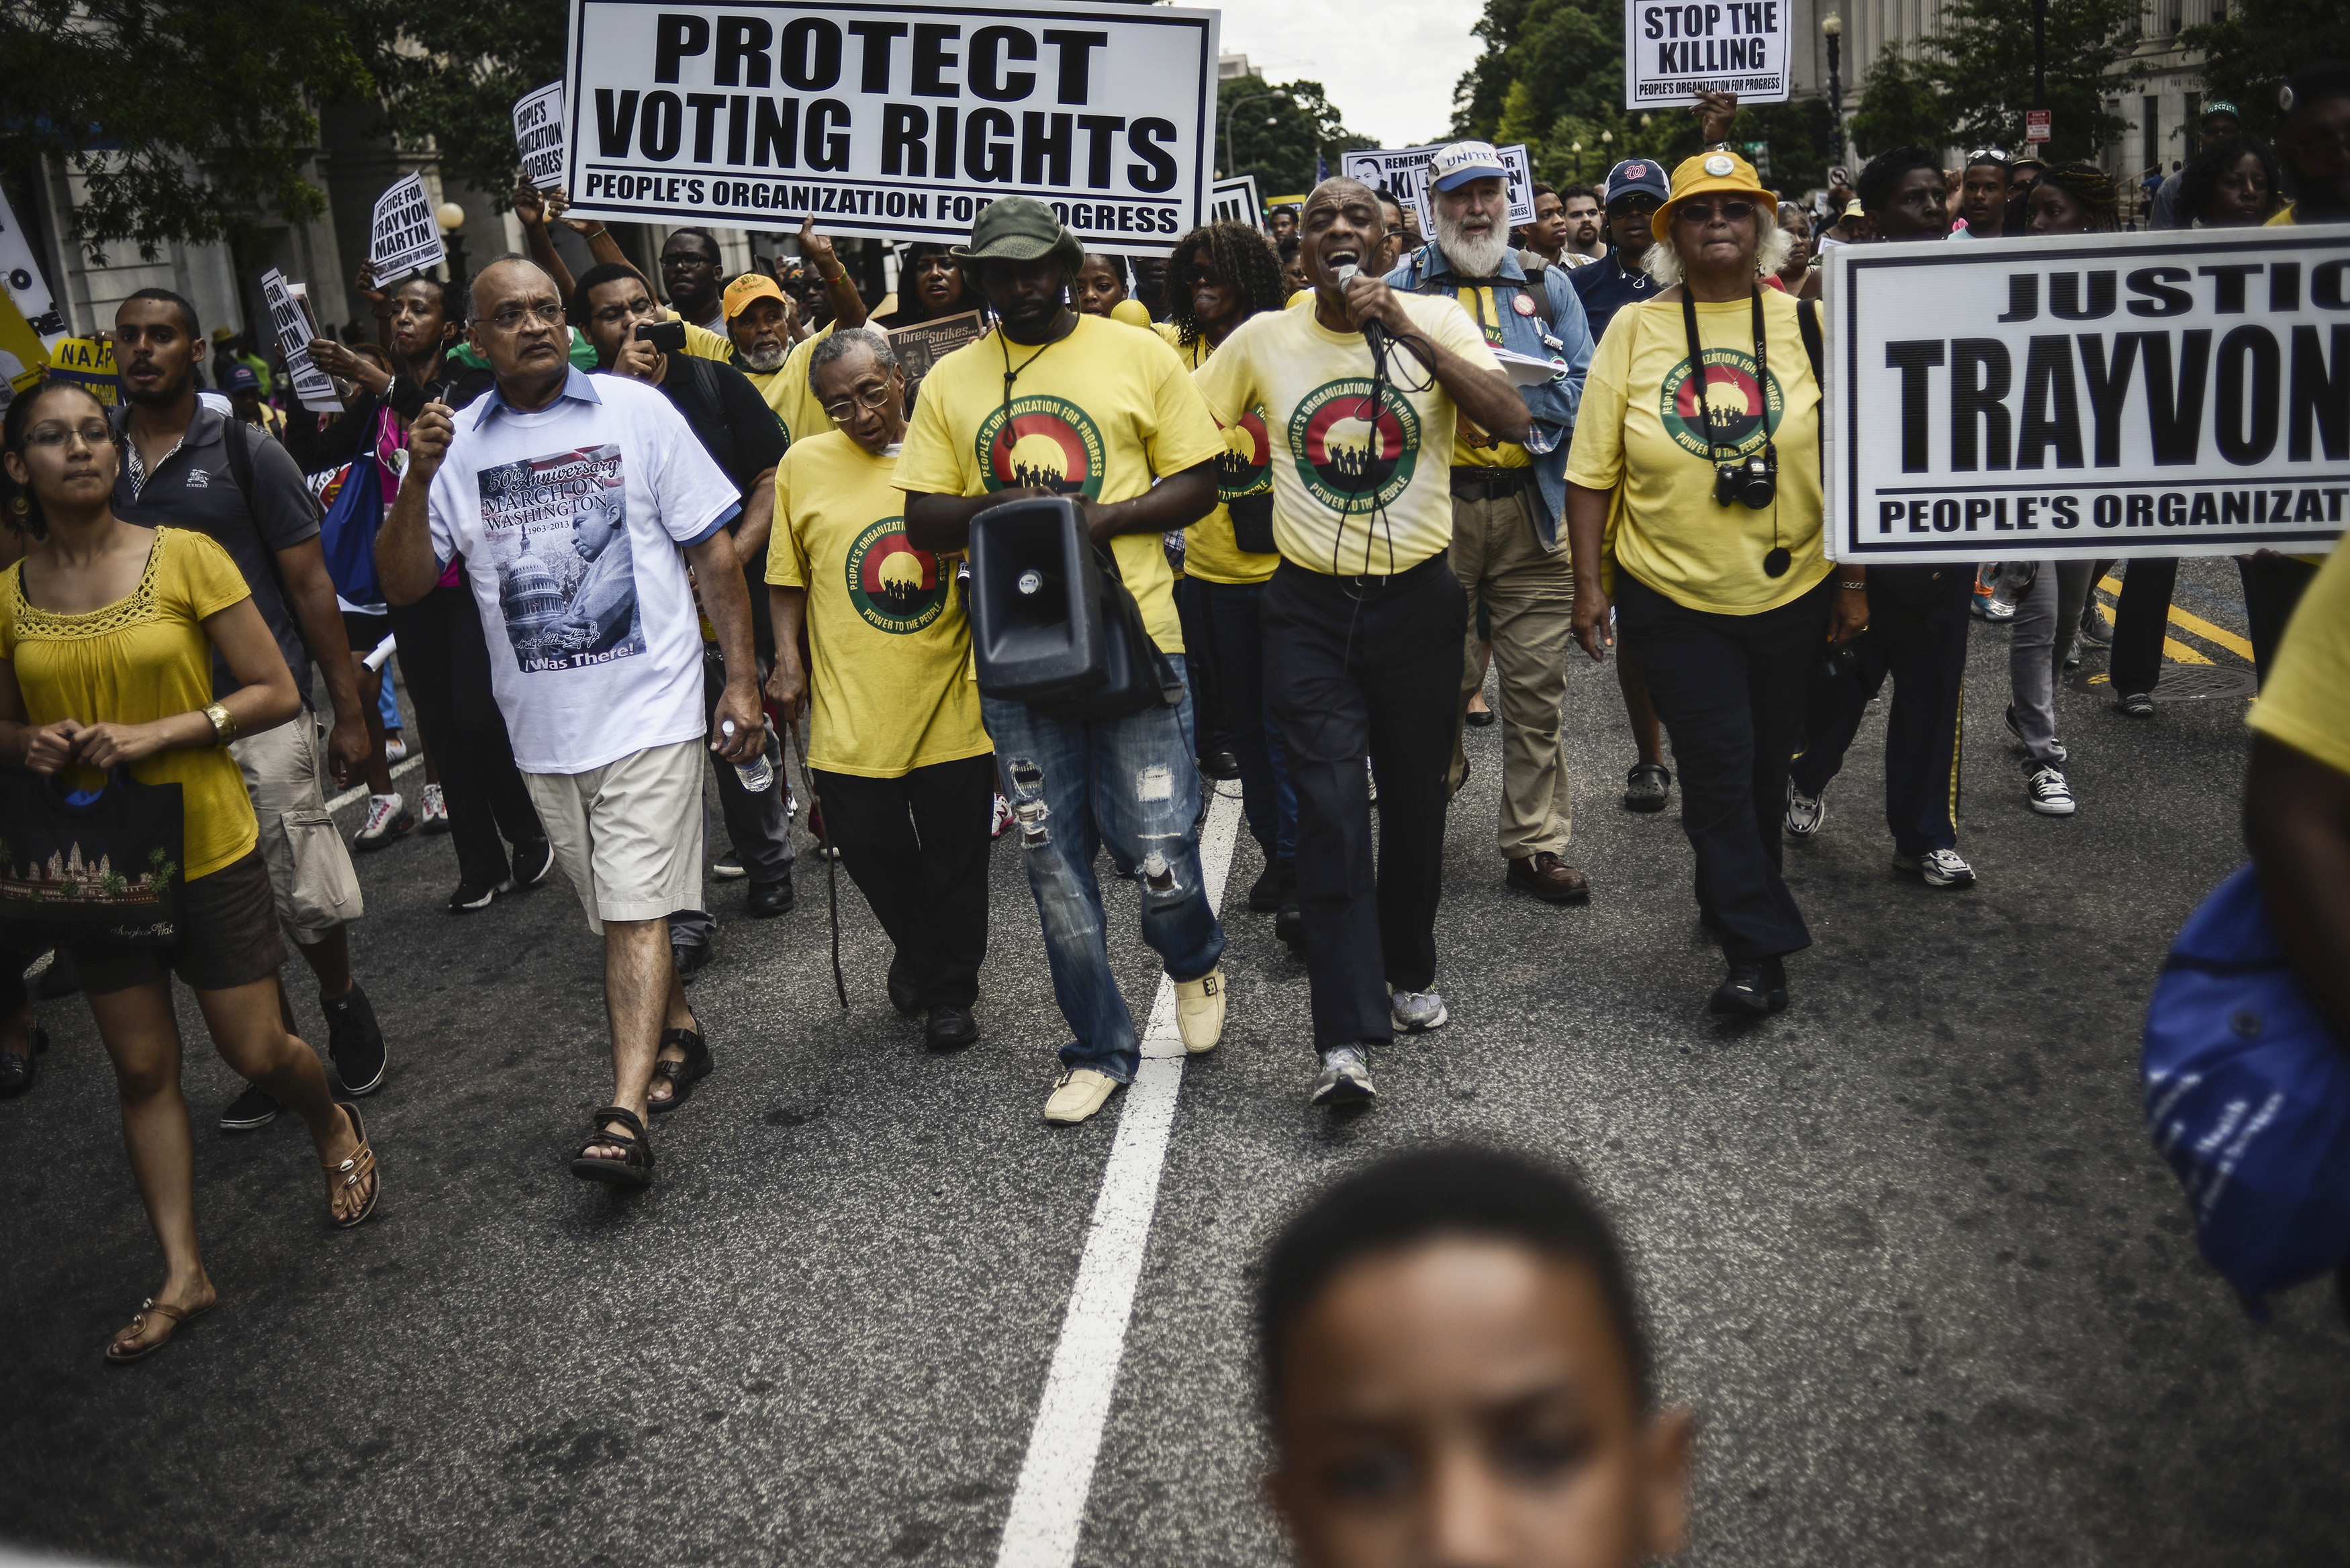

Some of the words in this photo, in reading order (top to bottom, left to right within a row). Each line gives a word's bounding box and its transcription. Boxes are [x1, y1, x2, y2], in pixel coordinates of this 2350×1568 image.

[1645, 4, 1720, 39] STOP
[1727, 1, 1778, 35] THE
[654, 13, 1107, 105] PROTECT
[1658, 37, 1766, 74] KILLING
[1639, 81, 1674, 96] PEOPLE'S
[1676, 79, 1730, 94] ORGANIZATION
[1731, 78, 1744, 91] FOR
[1745, 77, 1780, 91] PROGRESS
[518, 100, 547, 136] PEOPLE'S
[594, 87, 851, 173] VOTING
[881, 103, 1178, 193] RIGHTS
[523, 147, 563, 178] ROGRESS
[1447, 152, 1494, 167] UNITE!
[404, 184, 422, 203] FOR
[585, 174, 704, 205] PEOPLE'S
[712, 180, 929, 220] ORGANIZATION
[1047, 201, 1178, 234] OGRESS
[1509, 206, 1528, 217] GRESS
[375, 199, 430, 242] TRAYVON
[375, 222, 431, 260] MARTIN
[266, 283, 284, 305] FOR
[898, 330, 929, 344] Three
[1662, 378, 1679, 415] PEOPLE'S
[1885, 324, 2350, 474] TRAYVON
[1289, 413, 1307, 460] PEOPLE'S
[1301, 382, 1372, 415] ORGANIZATION
[1380, 389, 1395, 403] OR
[1392, 401, 1417, 450] PROGRESS
[980, 428, 994, 477] PEOPLE'S
[1061, 406, 1080, 425] FOR
[1077, 421, 1102, 477] PROGRESS
[1675, 432, 1708, 456] POWER
[1739, 430, 1768, 454] PEOPLE
[488, 470, 522, 491] 50th
[511, 459, 621, 491] Anniversary
[1309, 482, 1344, 508] POWER
[1360, 495, 1376, 511] THE
[1377, 475, 1409, 504] PEOPLE
[483, 483, 565, 517] MARCH
[572, 475, 606, 495] ON
[486, 495, 608, 531] WASHINGTON
[528, 520, 569, 536] 1963-2013
[1879, 495, 2079, 534] PEOPLE'S
[849, 548, 863, 590] PEOPLE'S
[863, 607, 893, 630] POWER
[895, 621, 904, 632] TO
[905, 618, 919, 630] THE
[919, 601, 942, 626] PEOPLE
[525, 660, 528, 672] I
[530, 657, 568, 671] Was
[571, 642, 634, 667] There!
